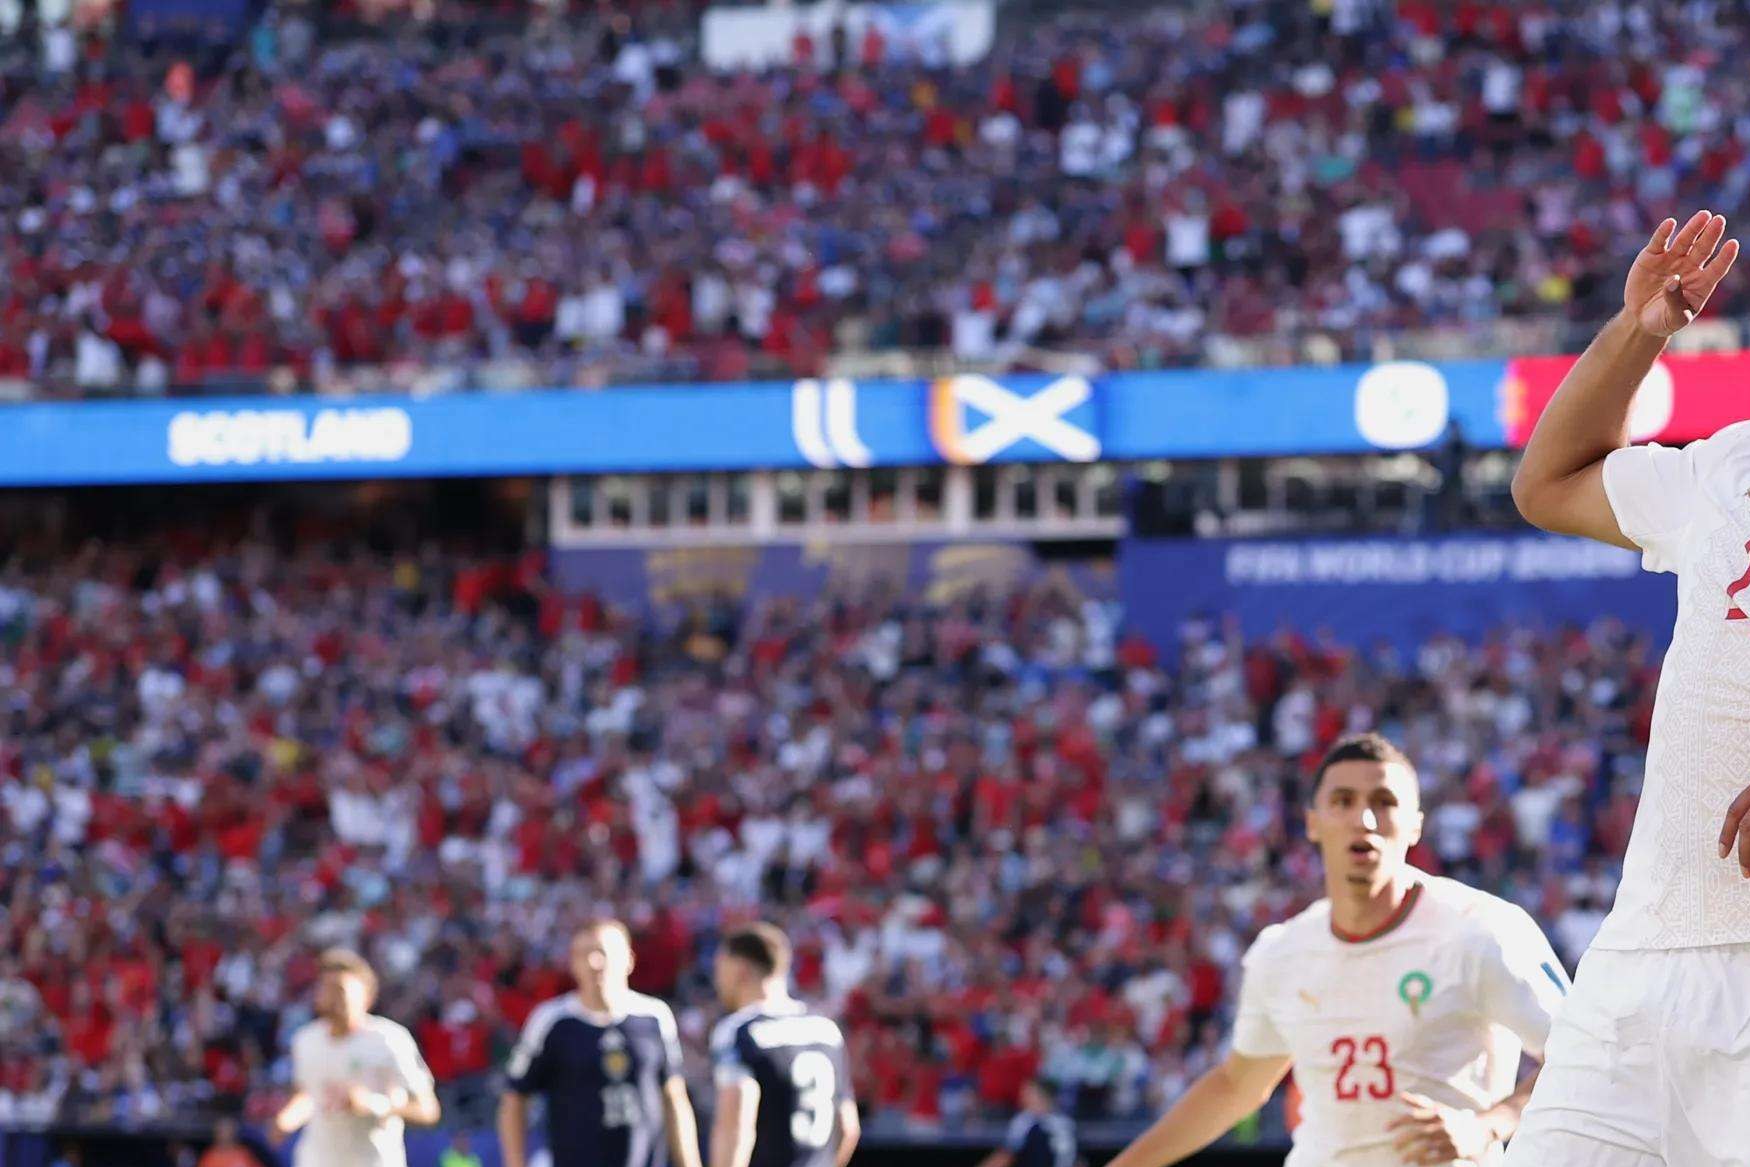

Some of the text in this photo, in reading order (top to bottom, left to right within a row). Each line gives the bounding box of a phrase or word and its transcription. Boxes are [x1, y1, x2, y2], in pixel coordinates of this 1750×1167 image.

[168, 409, 413, 467] SCOTLAND
[790, 1050, 835, 1148] 3
[1331, 1035, 1396, 1101] 23
